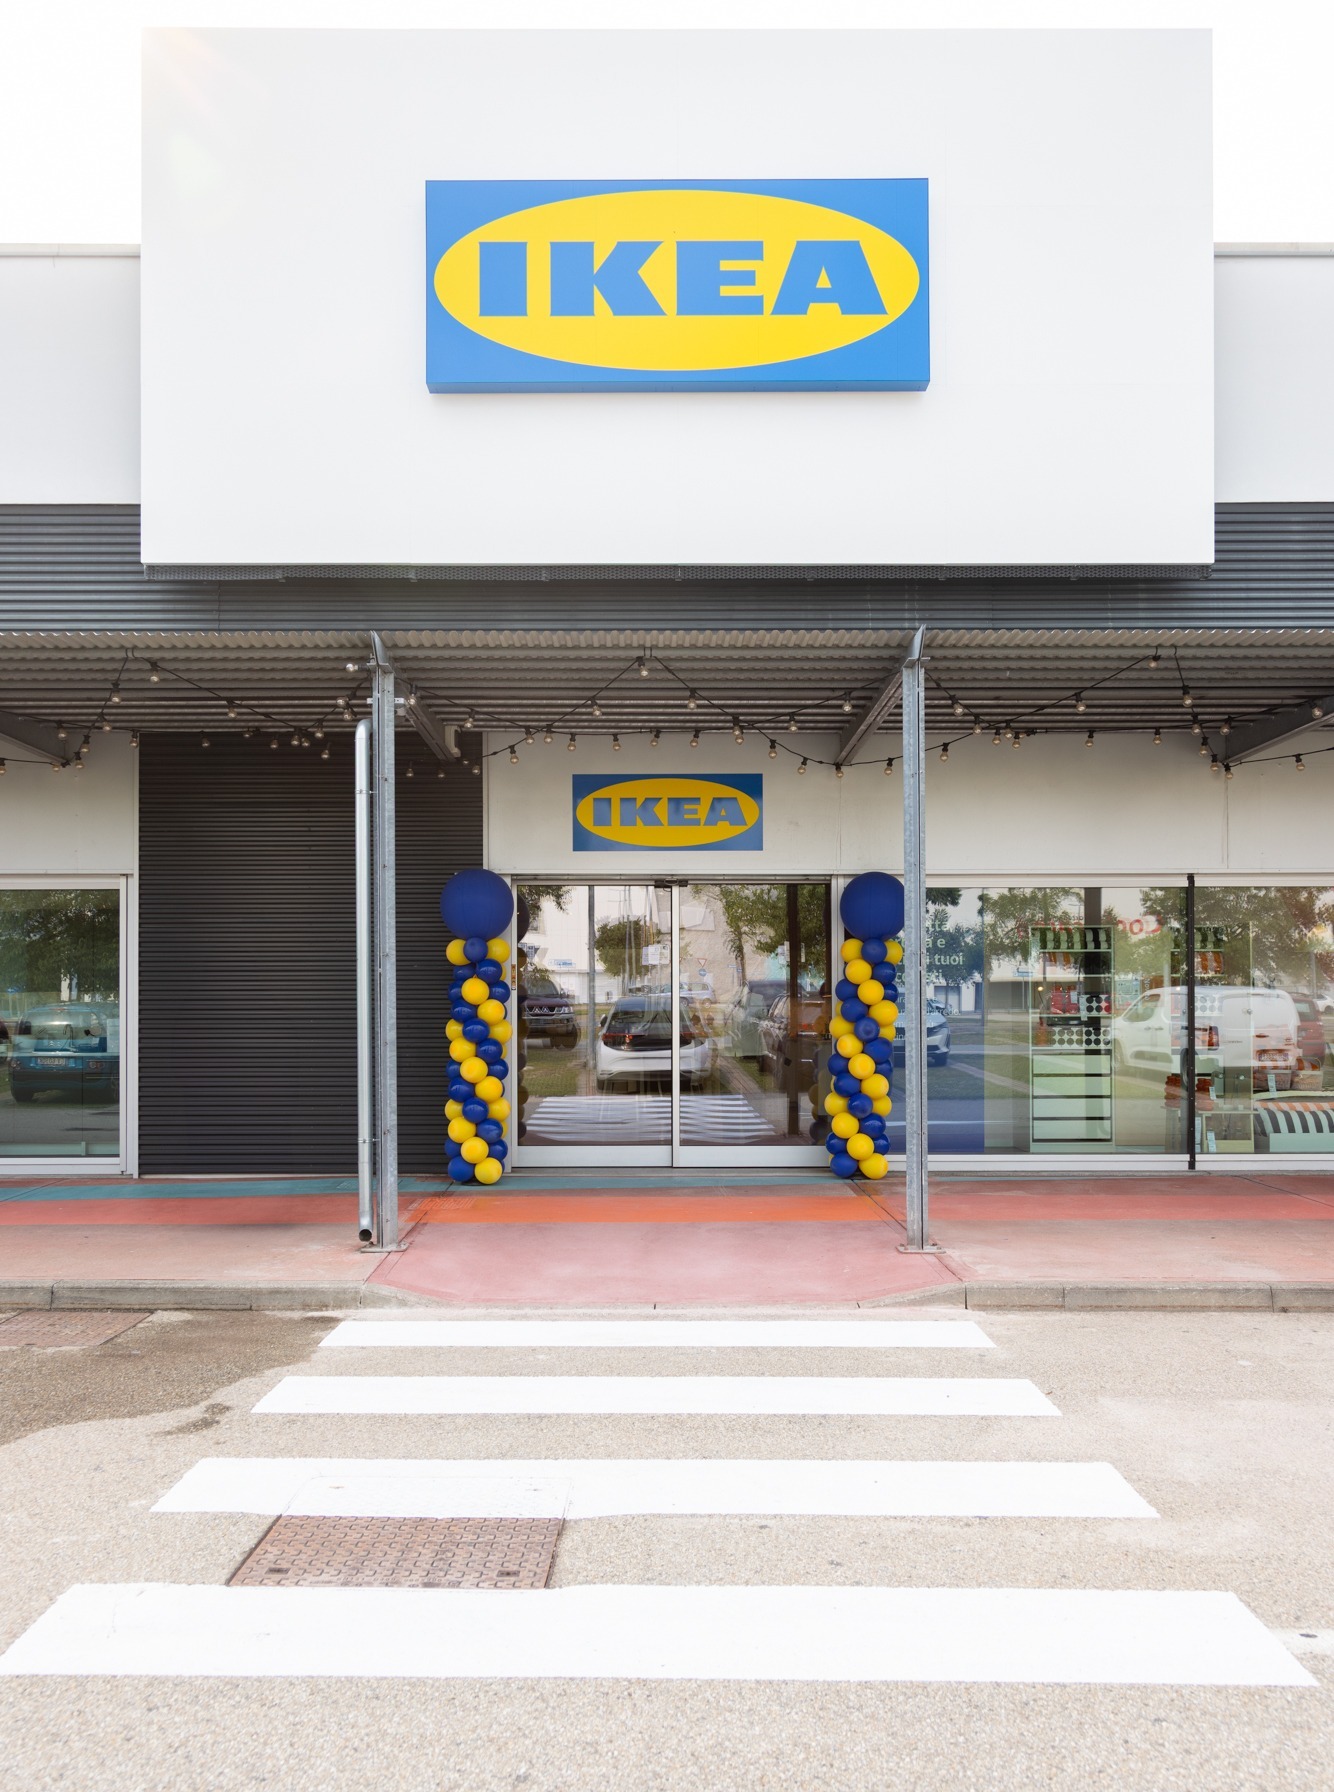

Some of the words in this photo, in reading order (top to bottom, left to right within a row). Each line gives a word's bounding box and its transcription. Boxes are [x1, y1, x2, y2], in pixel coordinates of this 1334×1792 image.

[478, 240, 889, 317] IKEA
[592, 797, 748, 827] IKEA
[934, 952, 963, 965] tuoi
